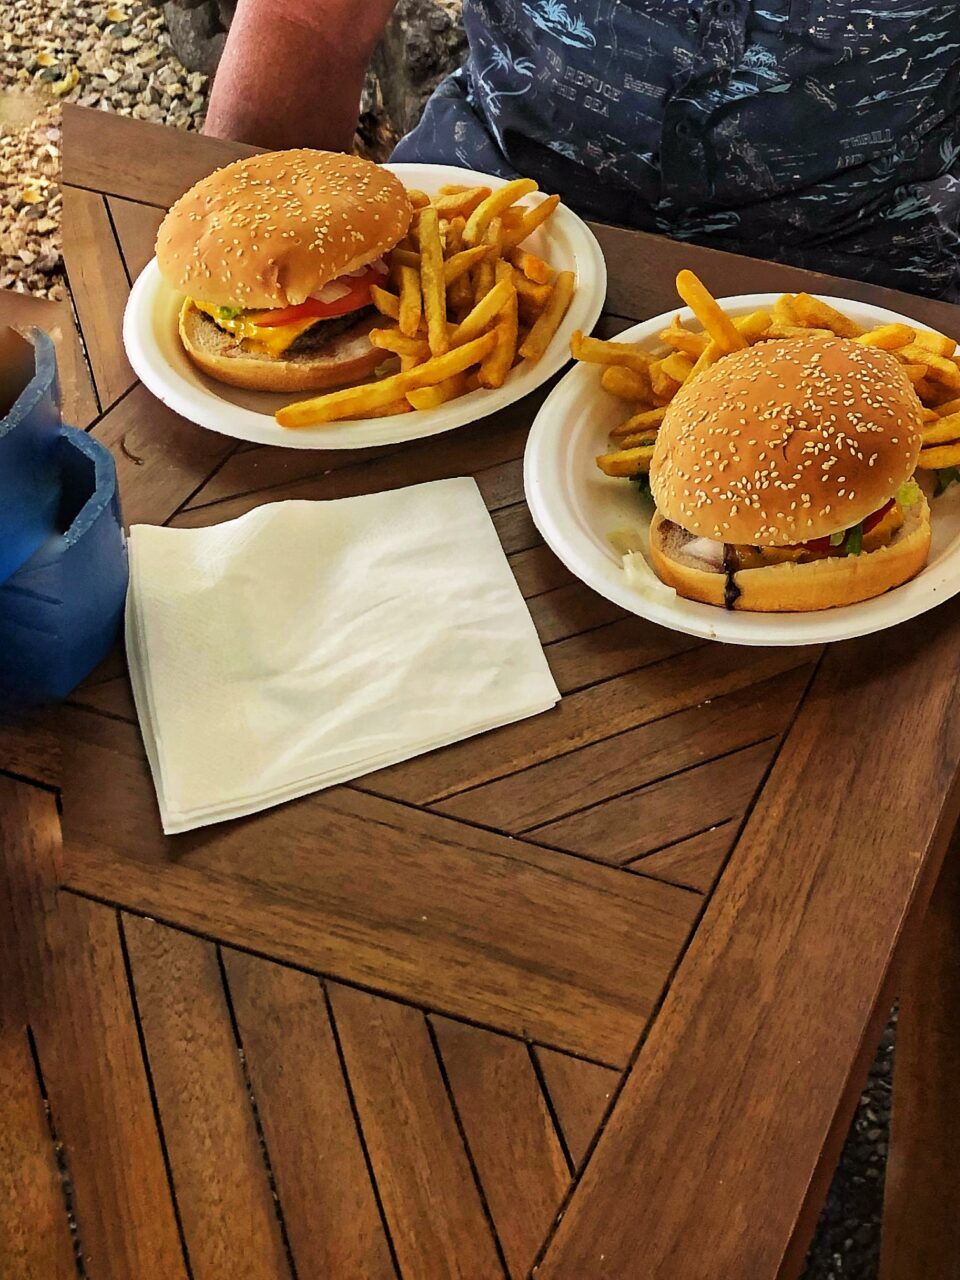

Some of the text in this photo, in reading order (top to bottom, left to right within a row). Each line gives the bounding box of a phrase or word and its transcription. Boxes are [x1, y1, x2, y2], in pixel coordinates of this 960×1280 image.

[563, 65, 623, 102] REFUGE
[583, 95, 609, 118] SEA
[839, 128, 895, 150] THRILL
